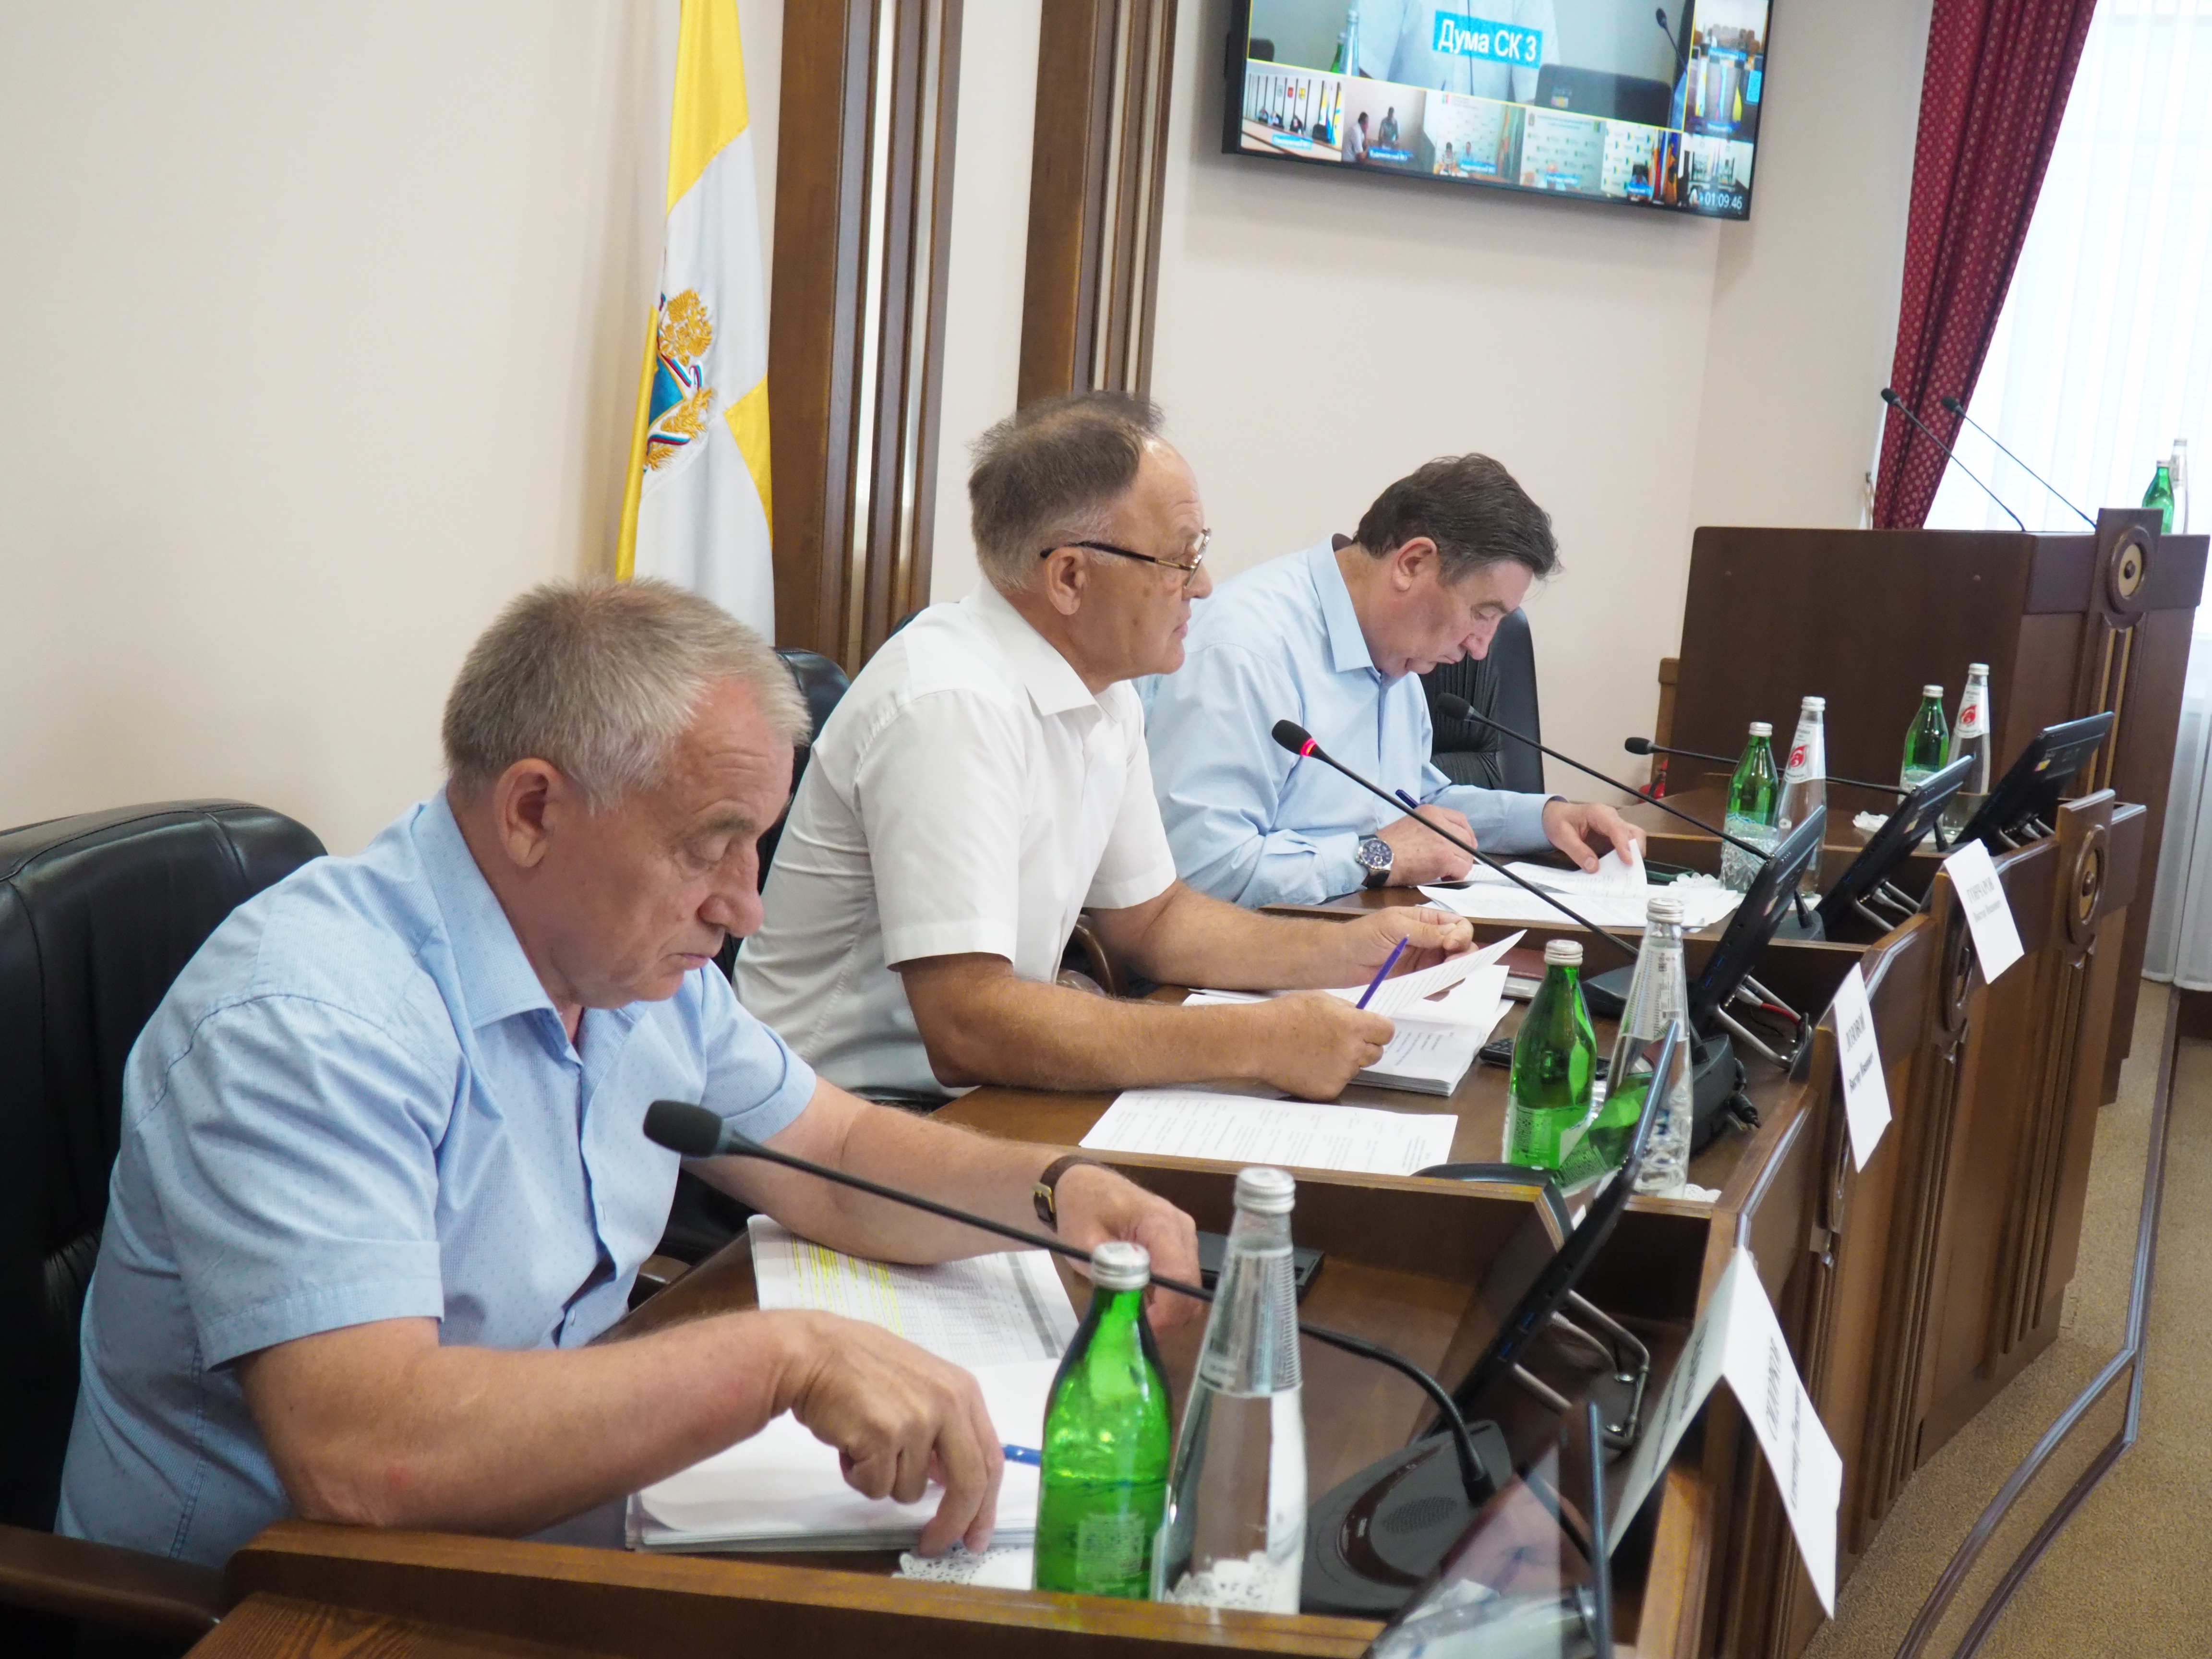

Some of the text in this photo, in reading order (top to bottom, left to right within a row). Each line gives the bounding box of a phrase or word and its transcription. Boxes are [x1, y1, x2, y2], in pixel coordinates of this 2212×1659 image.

[1438, 19, 1536, 61] Дума СК 3
[1705, 192, 1743, 210] 01:09:46
